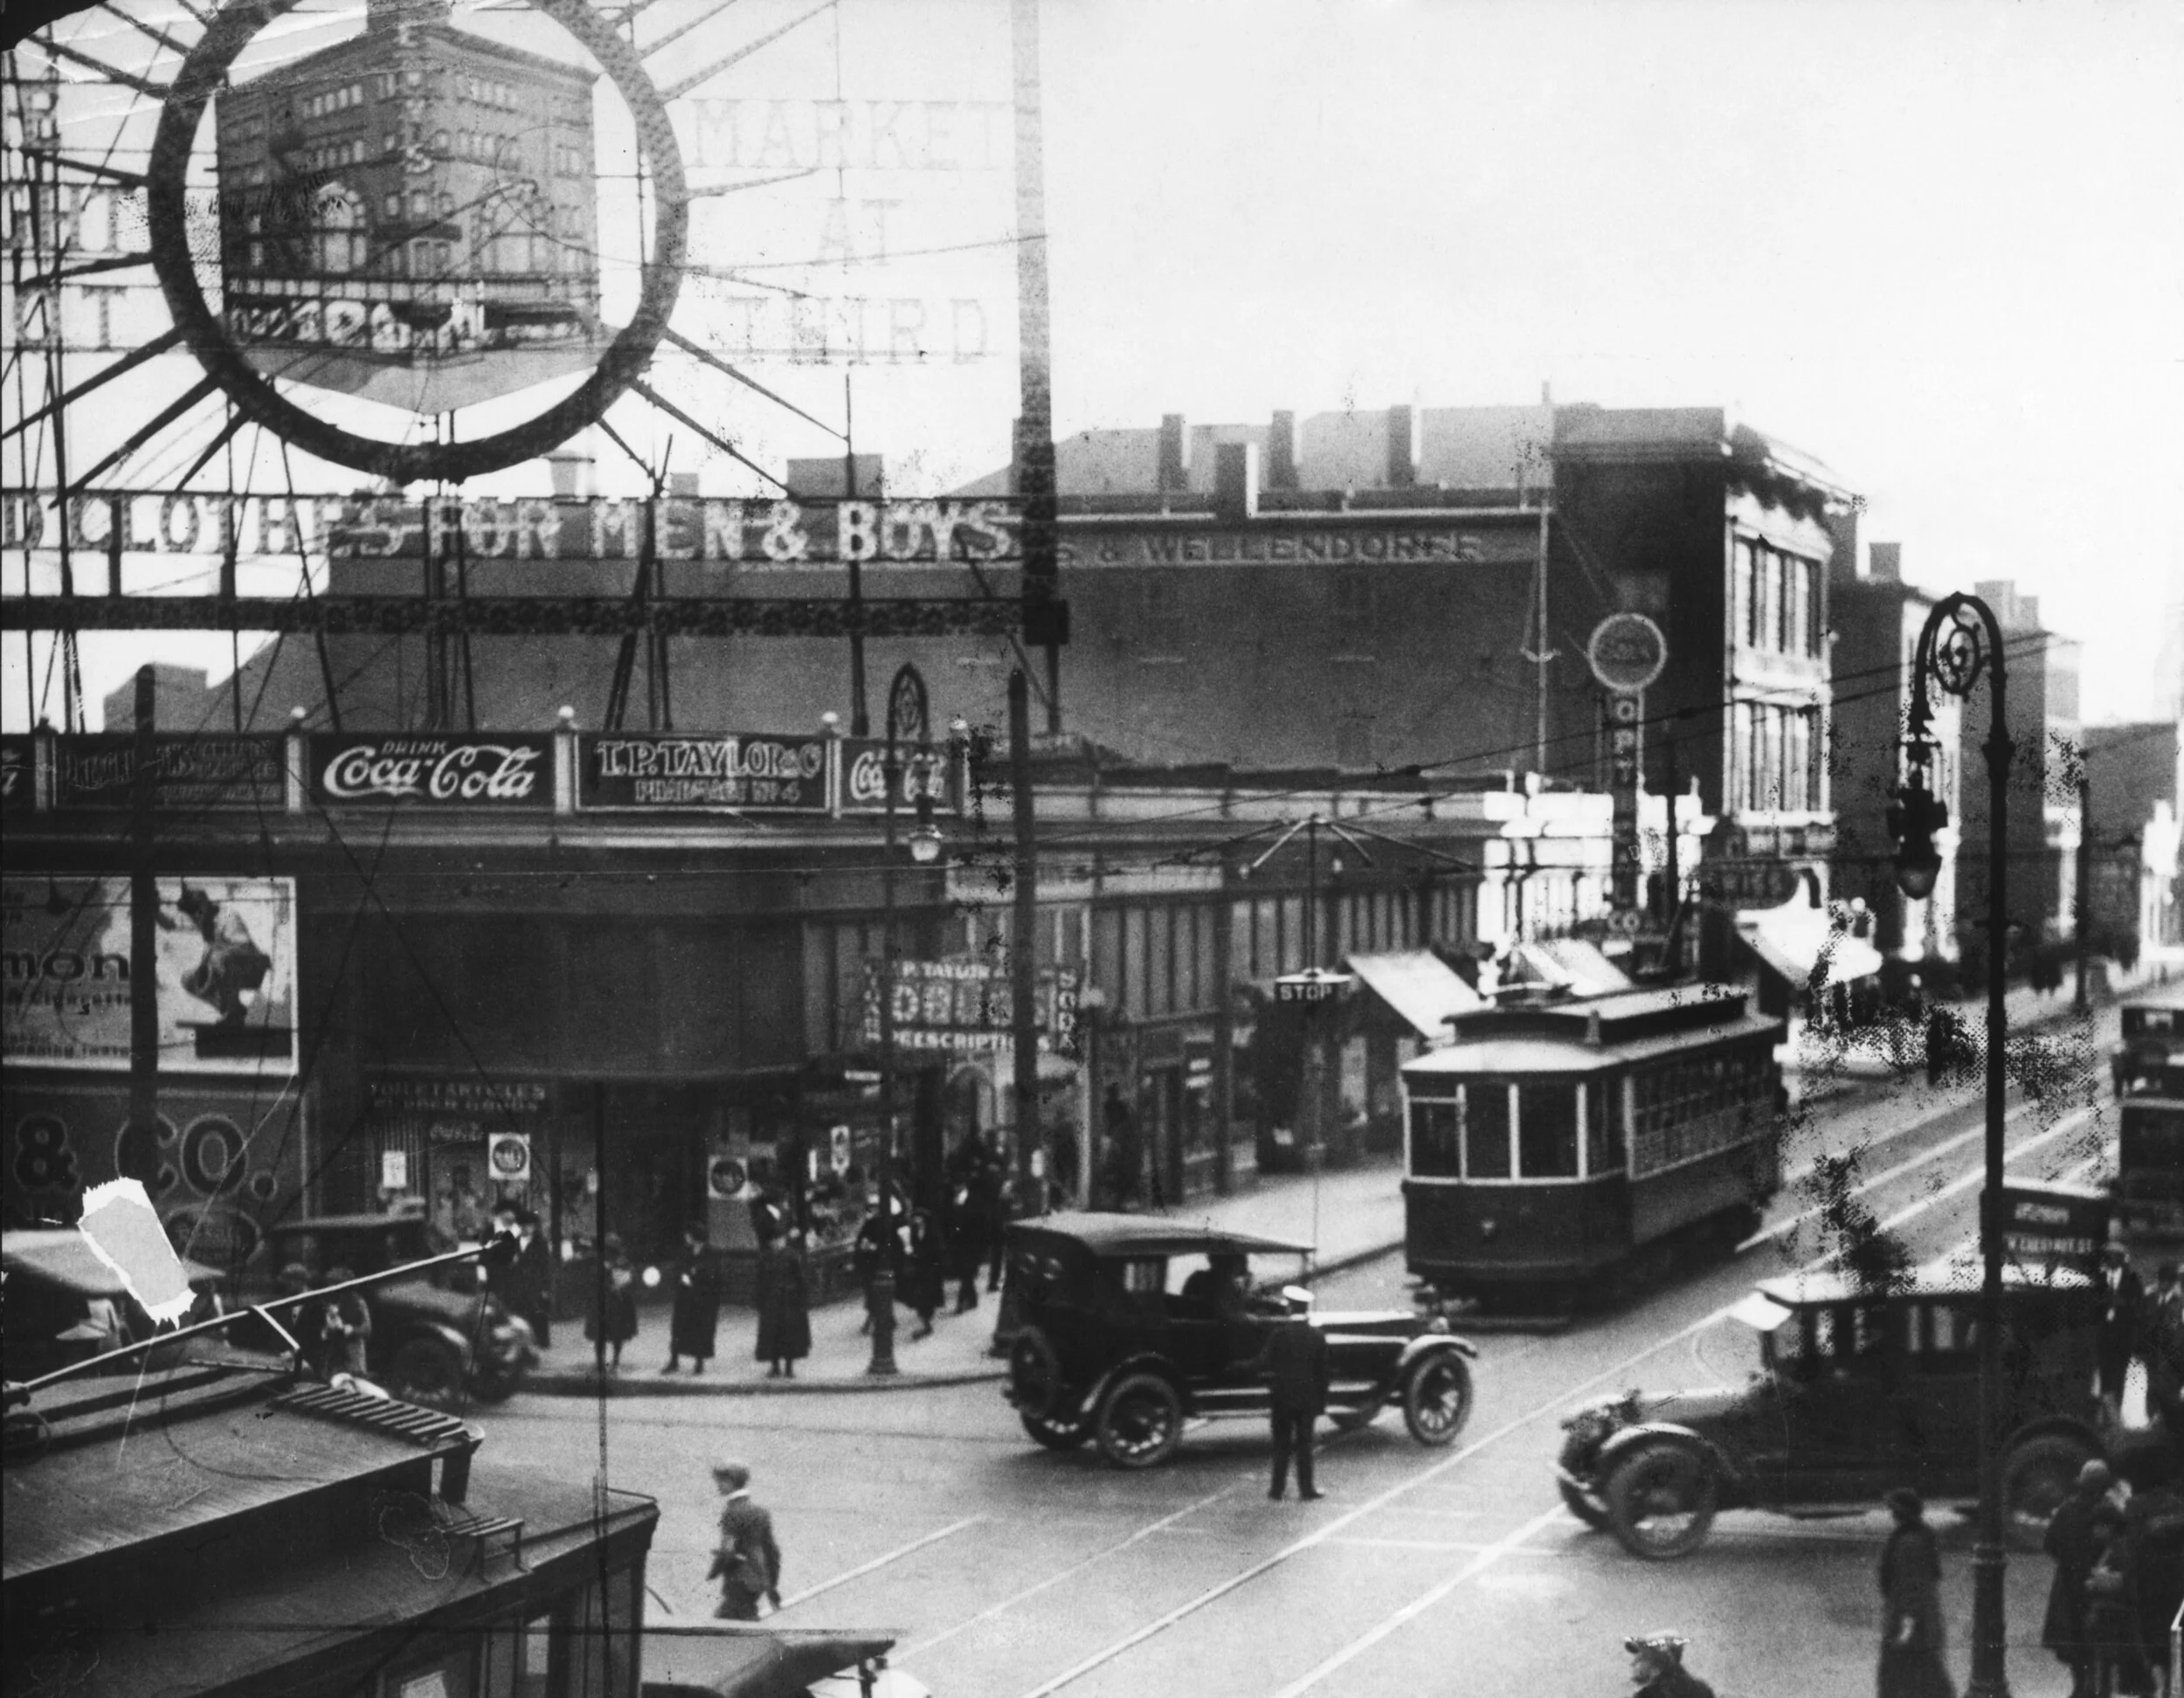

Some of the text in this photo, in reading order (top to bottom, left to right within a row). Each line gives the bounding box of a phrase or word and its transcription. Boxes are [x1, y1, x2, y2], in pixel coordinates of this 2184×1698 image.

[687, 98, 1013, 171] MARKET
[809, 197, 903, 266] AT
[726, 295, 988, 365] THIRD
[426, 496, 560, 559] FOR
[592, 498, 745, 560] MEN
[761, 500, 808, 561] &
[837, 500, 1014, 563] BOYS
[321, 745, 542, 799] Coca-Cola
[380, 740, 447, 756] DRINK
[1279, 984, 1333, 1002] STOP
[15, 1111, 81, 1191] &
